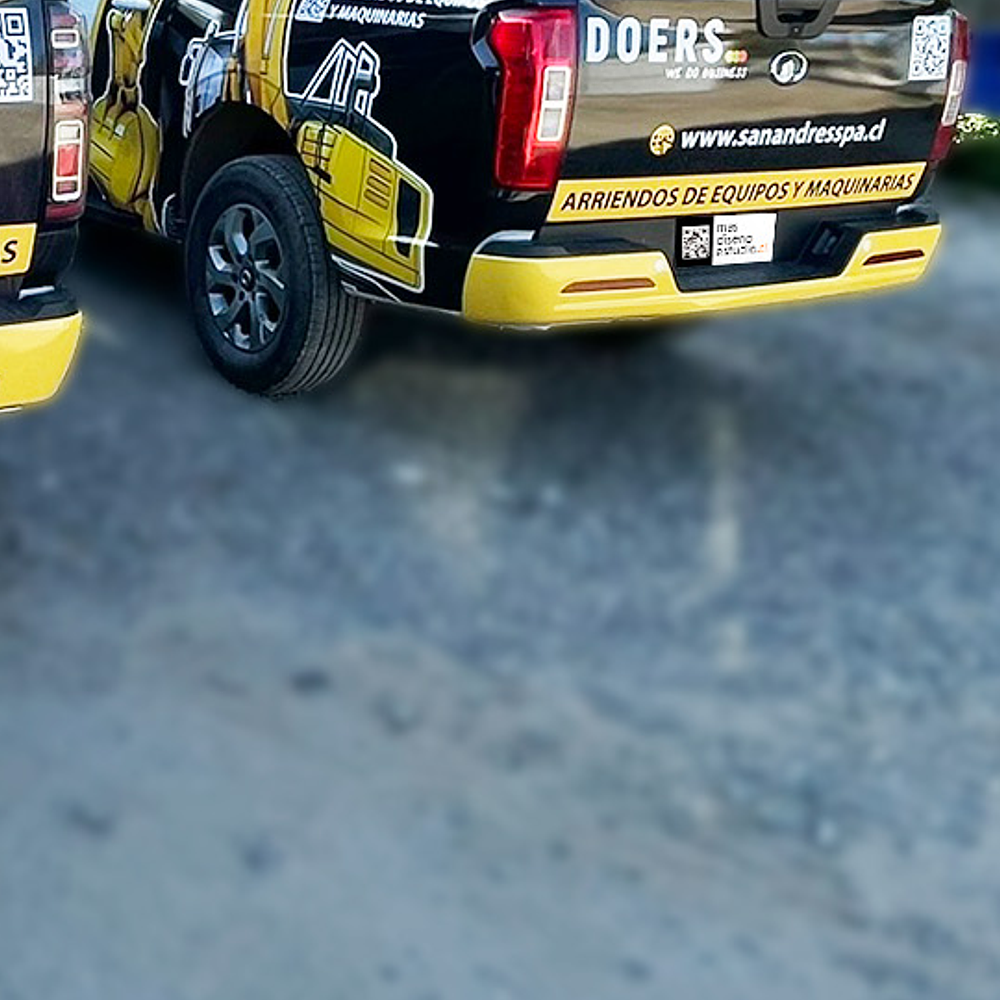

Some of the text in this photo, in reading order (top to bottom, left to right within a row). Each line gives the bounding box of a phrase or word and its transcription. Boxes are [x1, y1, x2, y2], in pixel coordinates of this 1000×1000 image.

[329, 3, 427, 29] Y MAQUINARIAS
[586, 16, 725, 64] DOERS
[681, 117, 888, 149] www.sanandresspa.cl
[561, 172, 916, 212] ARRIENDOS DE EQUIPOS Y MAQUINARIAS
